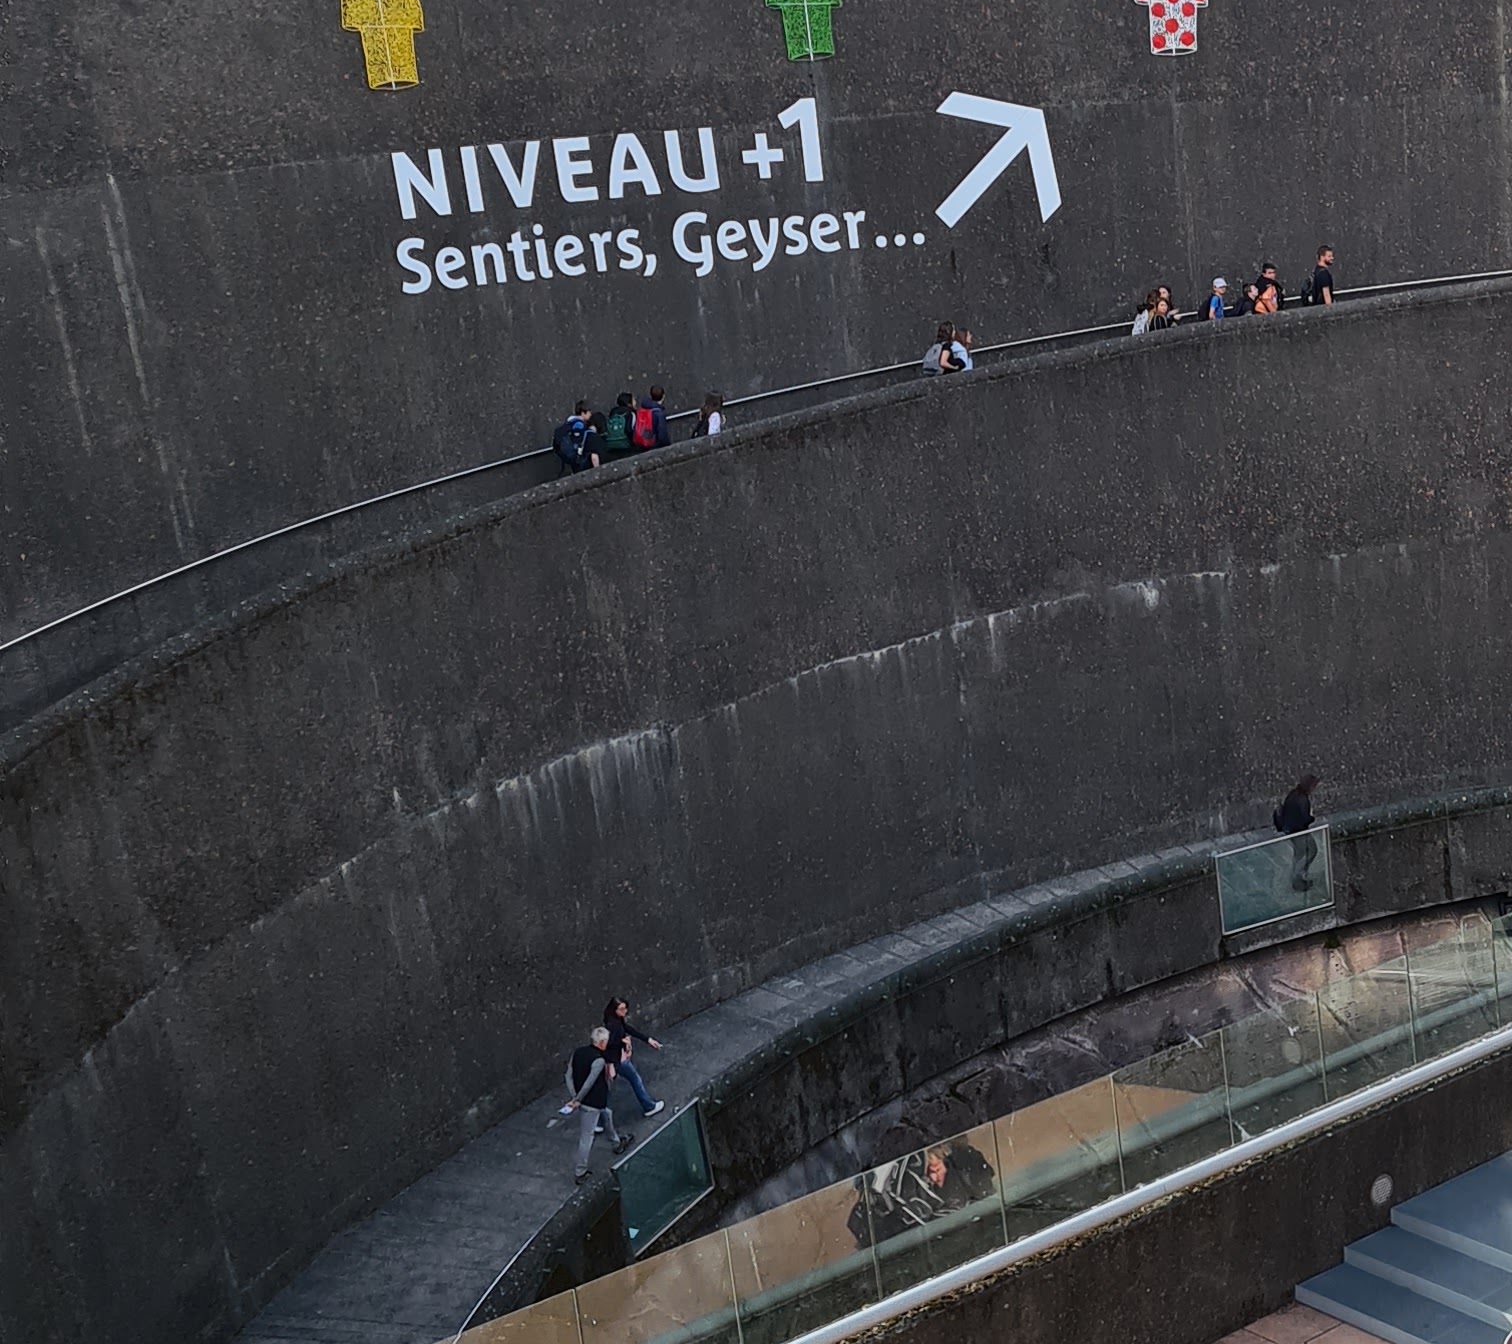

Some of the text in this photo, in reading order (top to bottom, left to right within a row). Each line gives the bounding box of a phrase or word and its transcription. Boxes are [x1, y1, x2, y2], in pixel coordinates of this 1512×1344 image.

[391, 97, 824, 220] NIVEAU +1
[396, 210, 926, 295] Sentiers, Geyser...
